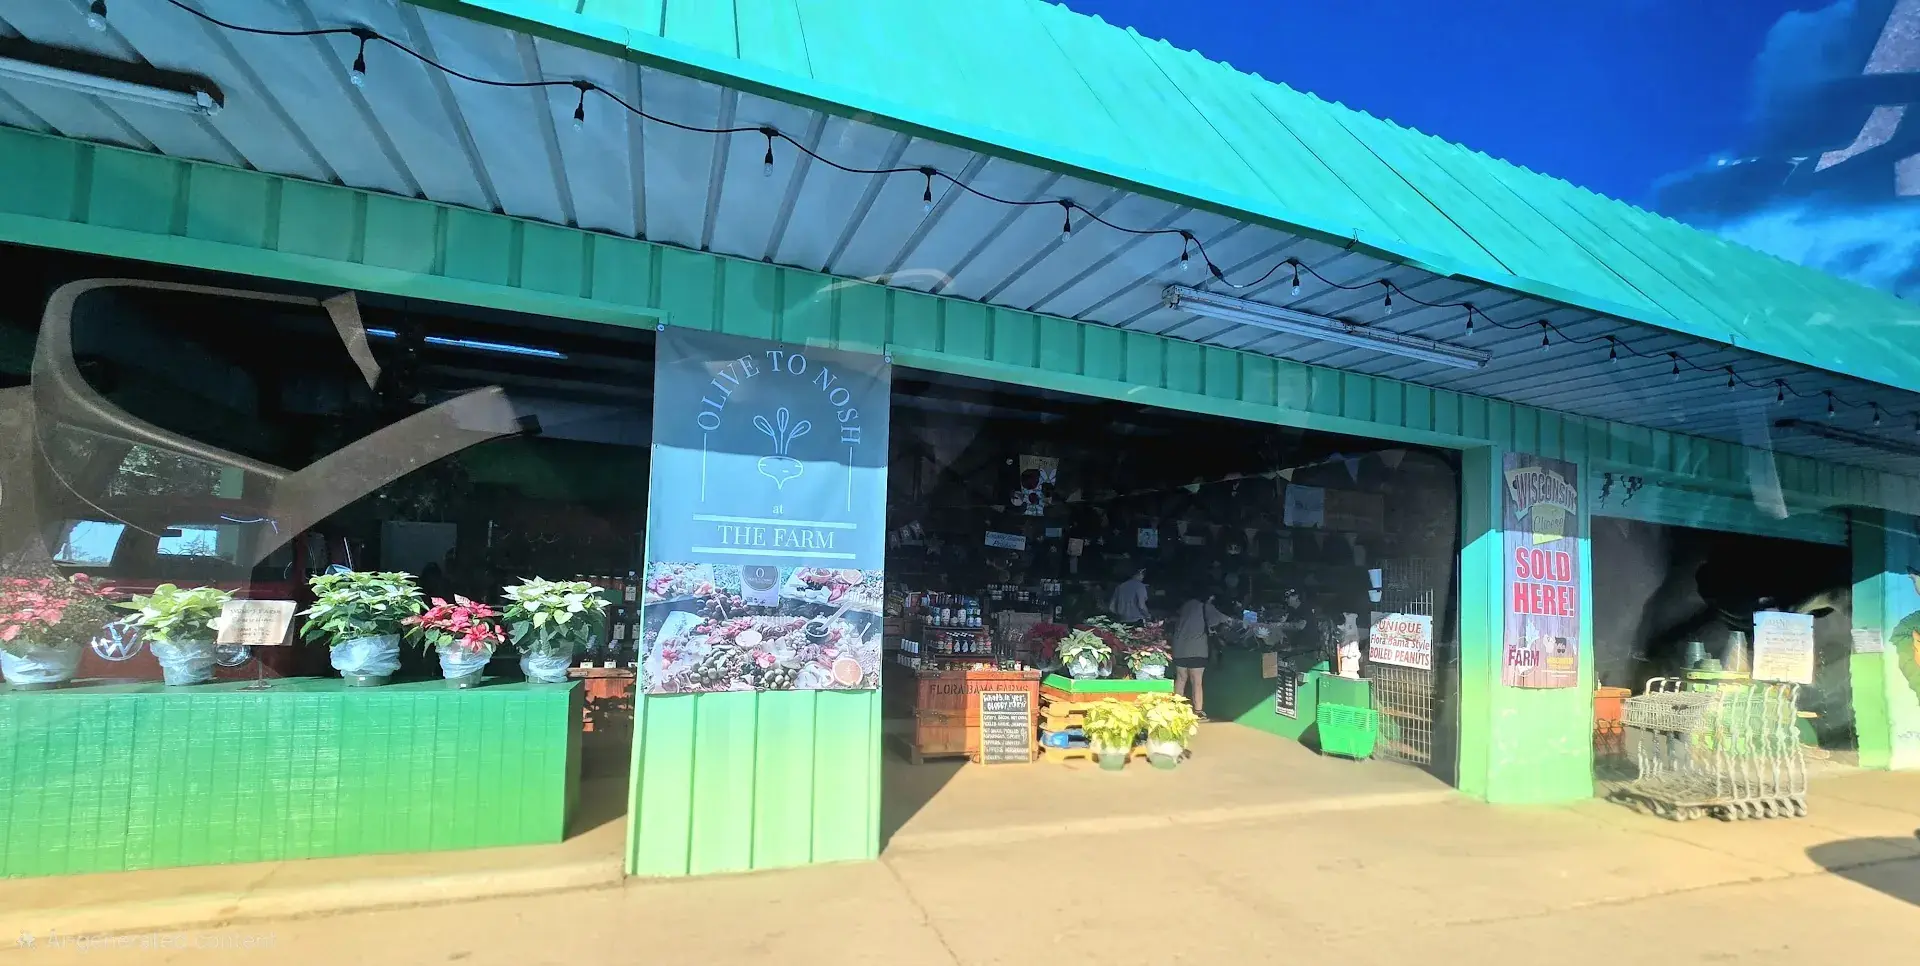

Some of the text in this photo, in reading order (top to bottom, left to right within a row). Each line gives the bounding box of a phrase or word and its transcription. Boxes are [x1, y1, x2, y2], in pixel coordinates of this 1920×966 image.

[697, 350, 861, 445] OLIVE TO NOSH
[1514, 471, 1577, 511] WISCONSIN
[772, 504, 784, 514] at
[717, 525, 835, 549] THE FARM
[1515, 546, 1571, 582] SOLD
[1513, 581, 1575, 617] HERE!
[1370, 634, 1386, 645] Flora
[1411, 640, 1430, 652] Style
[1369, 647, 1430, 666] BOILED PEANUTS
[1508, 649, 1540, 667] FARM
[930, 684, 964, 695] FLORA
